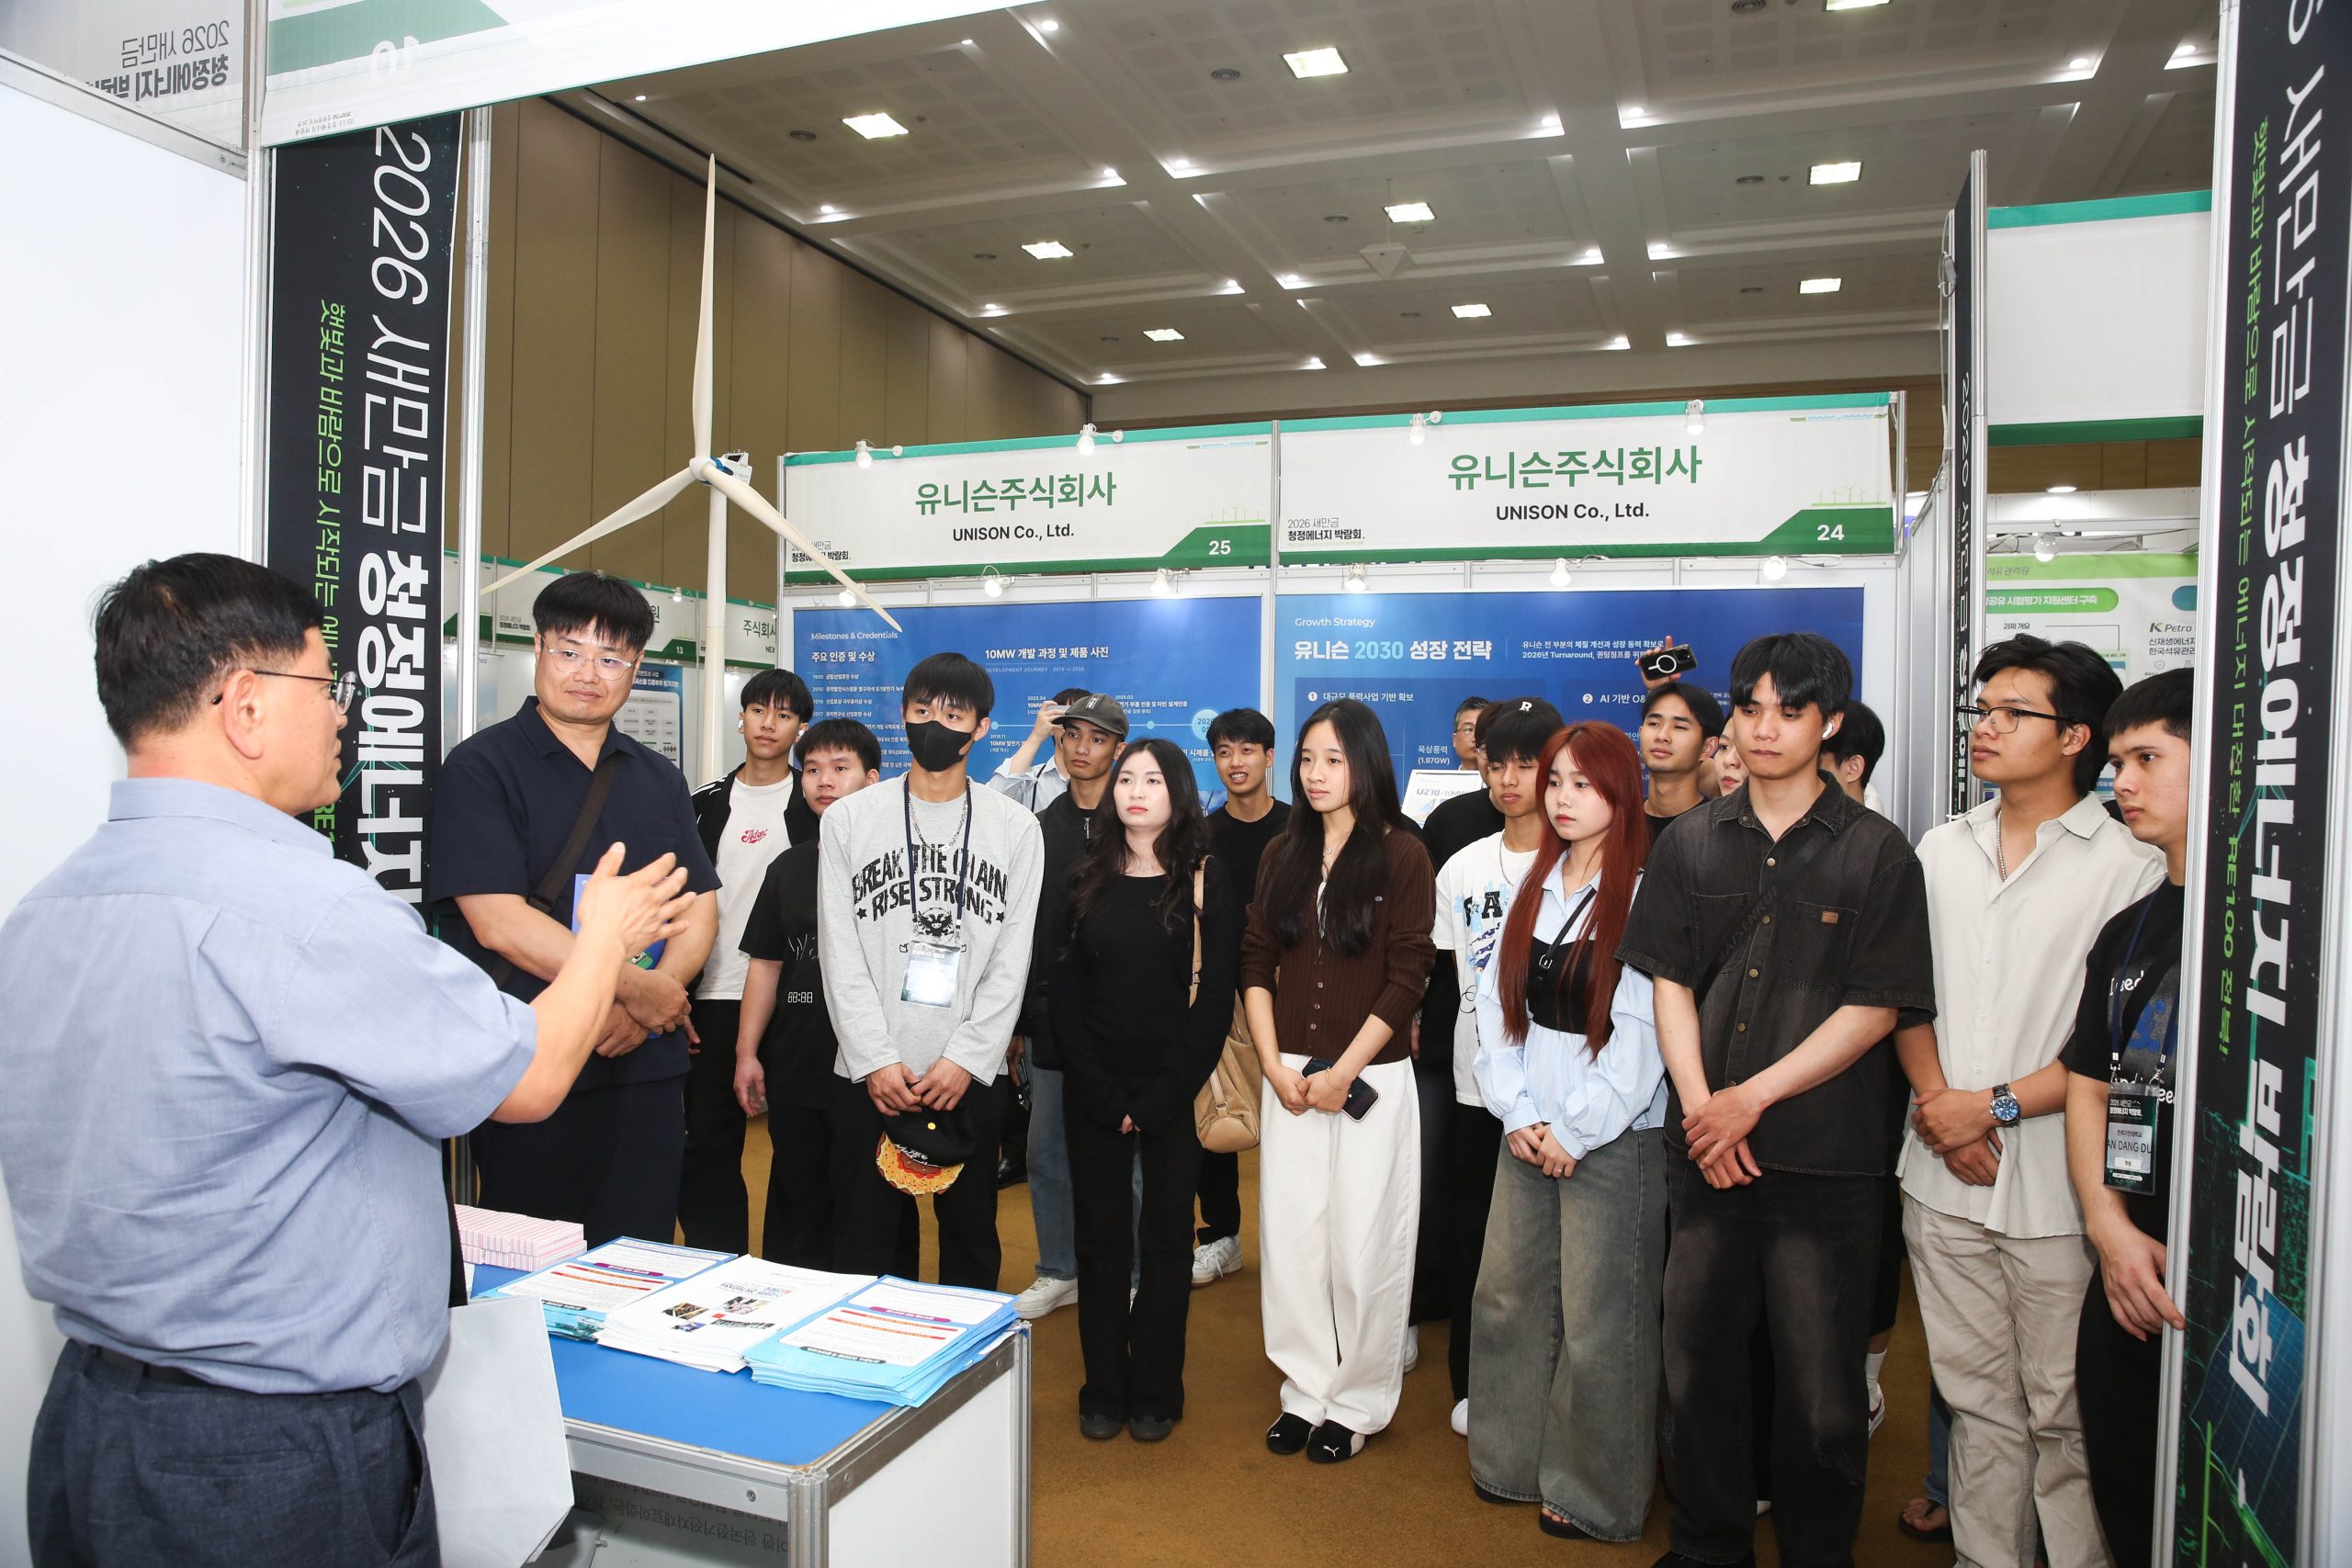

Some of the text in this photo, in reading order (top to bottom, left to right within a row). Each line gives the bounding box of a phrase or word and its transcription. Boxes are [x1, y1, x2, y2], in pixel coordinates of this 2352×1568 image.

[2250, 115, 2268, 240] 햇빛과
[2269, 63, 2324, 420] 새만금
[2245, 244, 2262, 405] 바람으로
[320, 299, 346, 382] 햇빛과
[318, 386, 344, 494] 바람으로
[1447, 445, 1702, 491] 유니슨주식회사
[915, 471, 1117, 515] 유니슨주식회사
[2237, 415, 2256, 566] 시작되는
[357, 126, 432, 904] 2026 새만금 청정에너지
[1496, 502, 1650, 522] UNISON Co., Ltd.
[953, 523, 1074, 542] UNISON Co., Ltd.
[1287, 516, 1340, 529] 2026 새만금
[1816, 524, 1845, 541] 24
[1287, 529, 1332, 541] 청정에너지
[315, 499, 341, 607] 시작되는
[1208, 539, 1231, 556] 25
[2042, 595, 2077, 605] 지원센터
[1295, 616, 1375, 628] Growth Strategy
[2165, 623, 2192, 633] Petro
[811, 632, 849, 640] Milestones
[857, 631, 899, 639] Credentials
[2233, 576, 2250, 689] 에너지
[985, 647, 1109, 660] 10MW 개발 과정 및 제품 사진
[1295, 640, 1492, 660] 유니슨 2030 성장 전략
[1521, 640, 1543, 649] 유니슨
[1544, 640, 1552, 649] 전
[1589, 640, 1611, 649] 개선과
[1611, 640, 1626, 649] 성장
[811, 651, 876, 662] 주요 인증 및 수상
[1521, 650, 1548, 659] 2026년
[1550, 651, 1595, 660] Turnaround,
[1381, 693, 1396, 702] 기반
[1398, 693, 1415, 702] 확보
[1600, 694, 1610, 704] AI
[1611, 694, 1630, 704] 기반
[2245, 434, 2310, 1027] 청정에너지
[1418, 745, 1448, 755] 육상풍력
[1418, 757, 1450, 765] (1.97GW)
[2229, 703, 2246, 818] 대전환
[852, 847, 904, 905] BREAK
[911, 843, 947, 874] THE
[872, 880, 910, 922] RISE
[2222, 836, 2239, 959] RE100
[2118, 1140, 2138, 1152] DANG
[2229, 1057, 2283, 1417] 박람회
